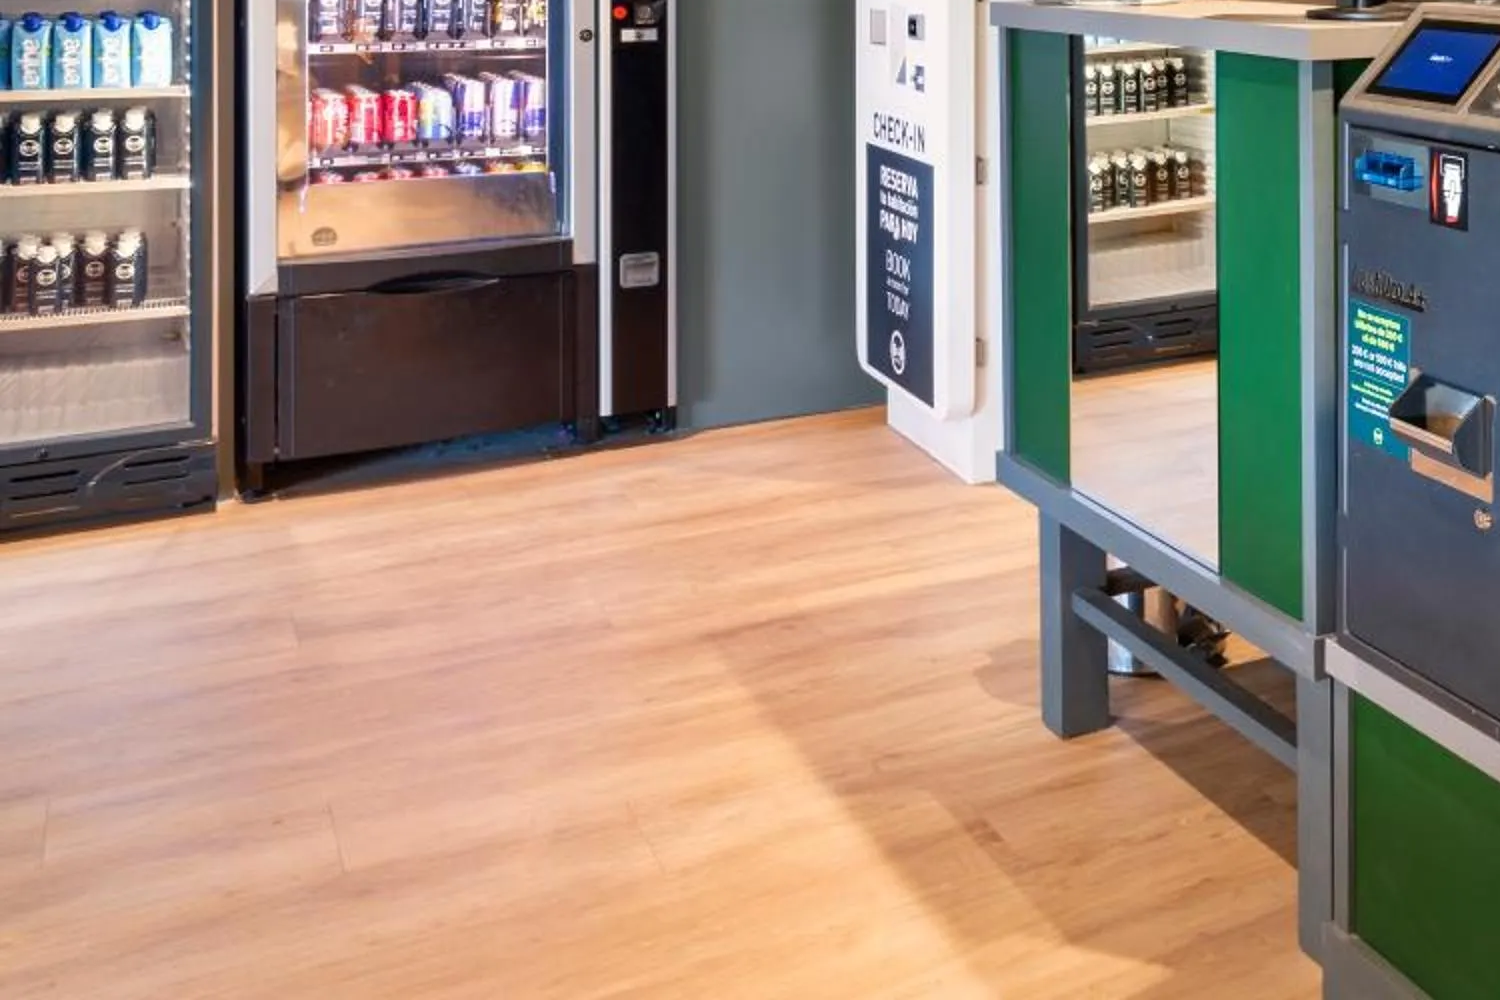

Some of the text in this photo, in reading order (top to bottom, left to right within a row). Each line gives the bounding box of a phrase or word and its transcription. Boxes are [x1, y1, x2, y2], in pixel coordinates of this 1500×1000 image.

[873, 111, 926, 153] CHECK-IN
[880, 164, 919, 200] RESERVA
[885, 249, 911, 281] BOOK
